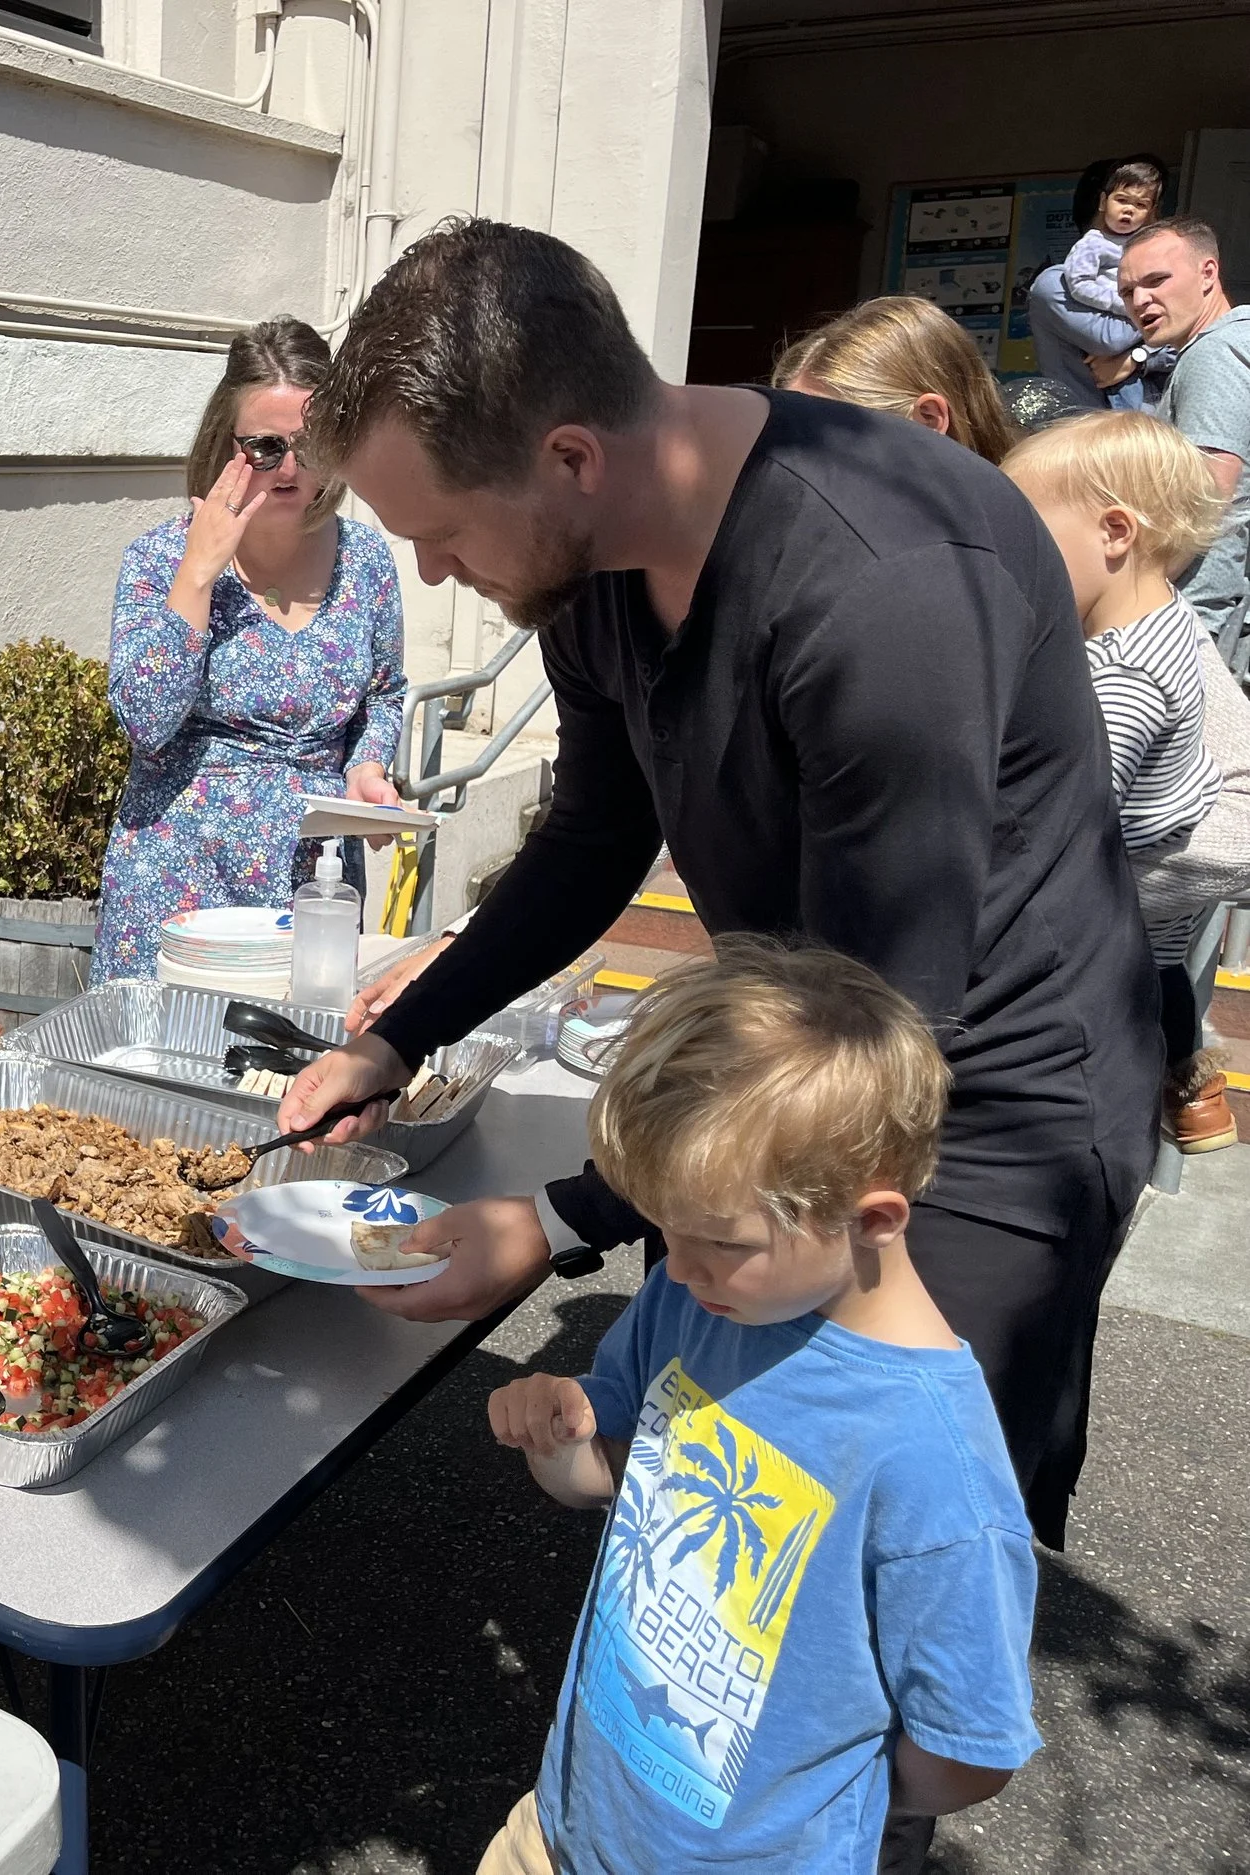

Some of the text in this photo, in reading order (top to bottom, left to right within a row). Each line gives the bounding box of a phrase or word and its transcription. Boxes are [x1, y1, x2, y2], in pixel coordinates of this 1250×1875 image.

[636, 1605, 755, 1717] BEACH
[658, 1579, 764, 1683] EDISTO
[628, 1743, 716, 1820] carolina
